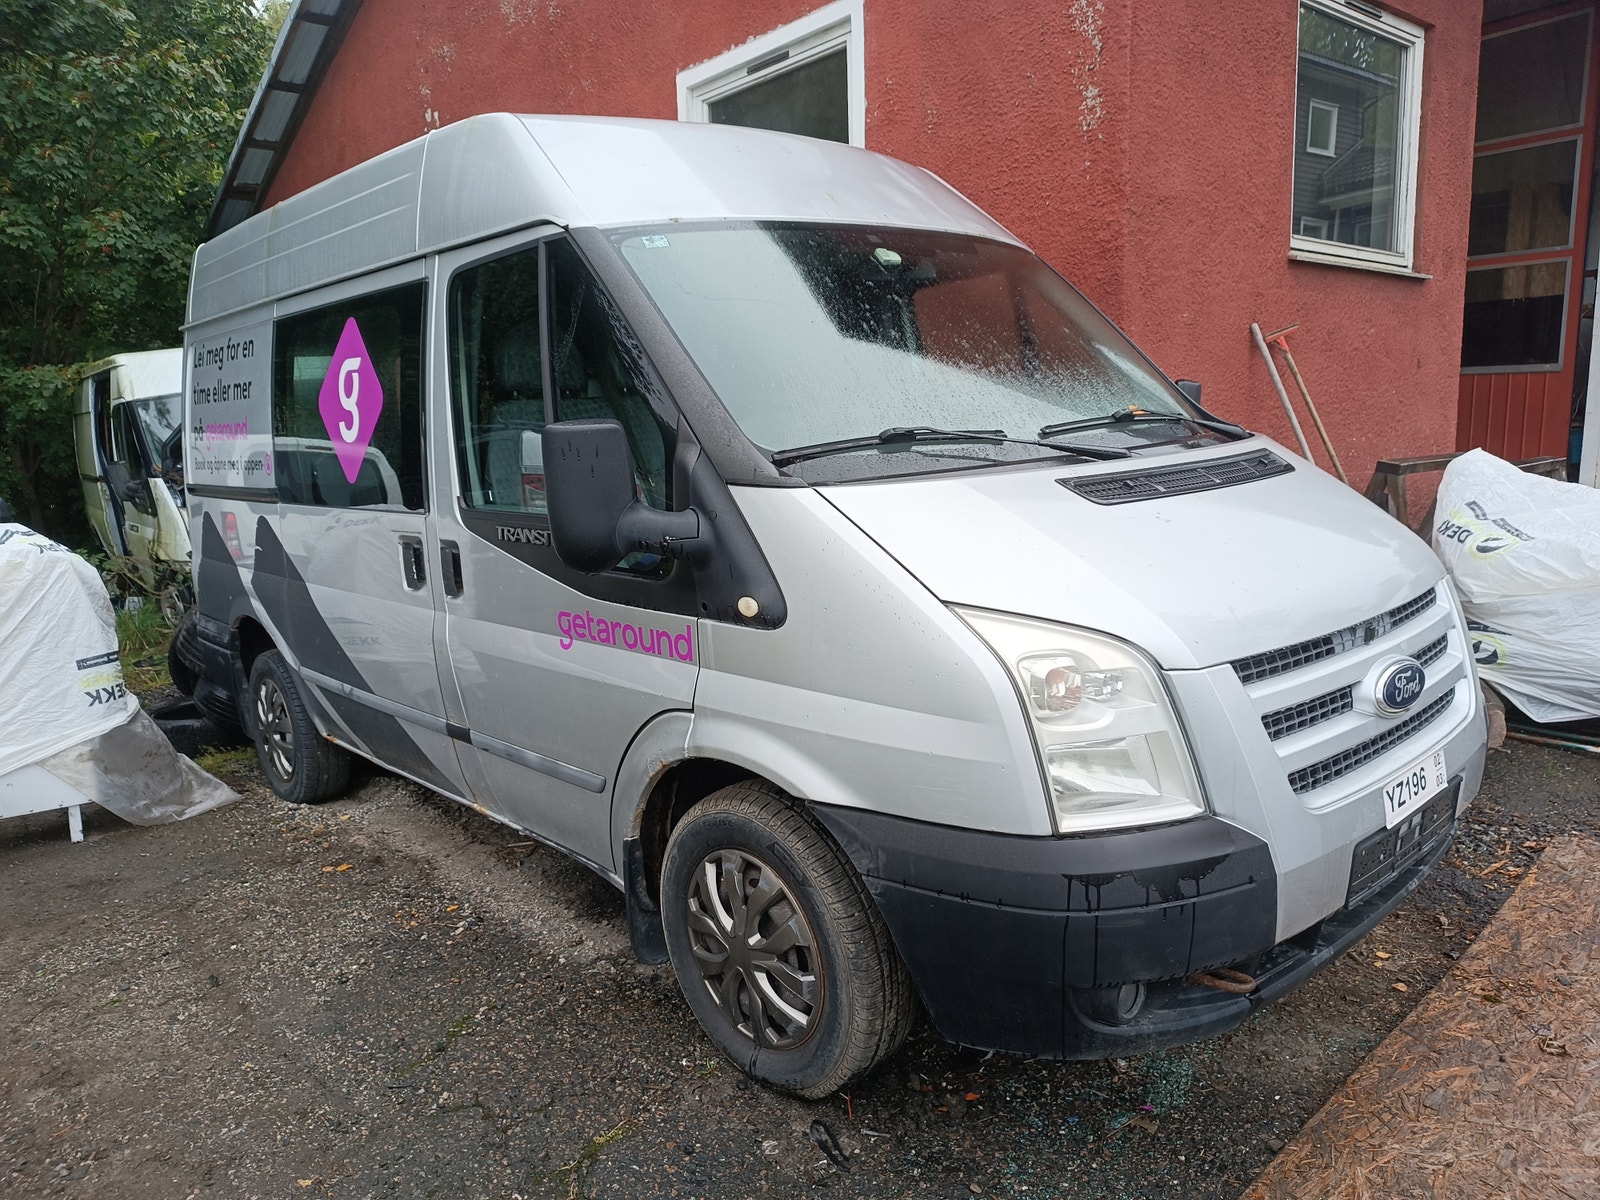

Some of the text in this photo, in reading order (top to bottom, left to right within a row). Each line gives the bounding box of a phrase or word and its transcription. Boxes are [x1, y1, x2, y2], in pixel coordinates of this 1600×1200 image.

[194, 337, 254, 371] Lei meg for en
[193, 378, 252, 406] time eller mer
[205, 415, 249, 452] getaround
[557, 610, 694, 662] getaround
[1395, 670, 1421, 702] Ford
[1385, 766, 1427, 813] YZ196
